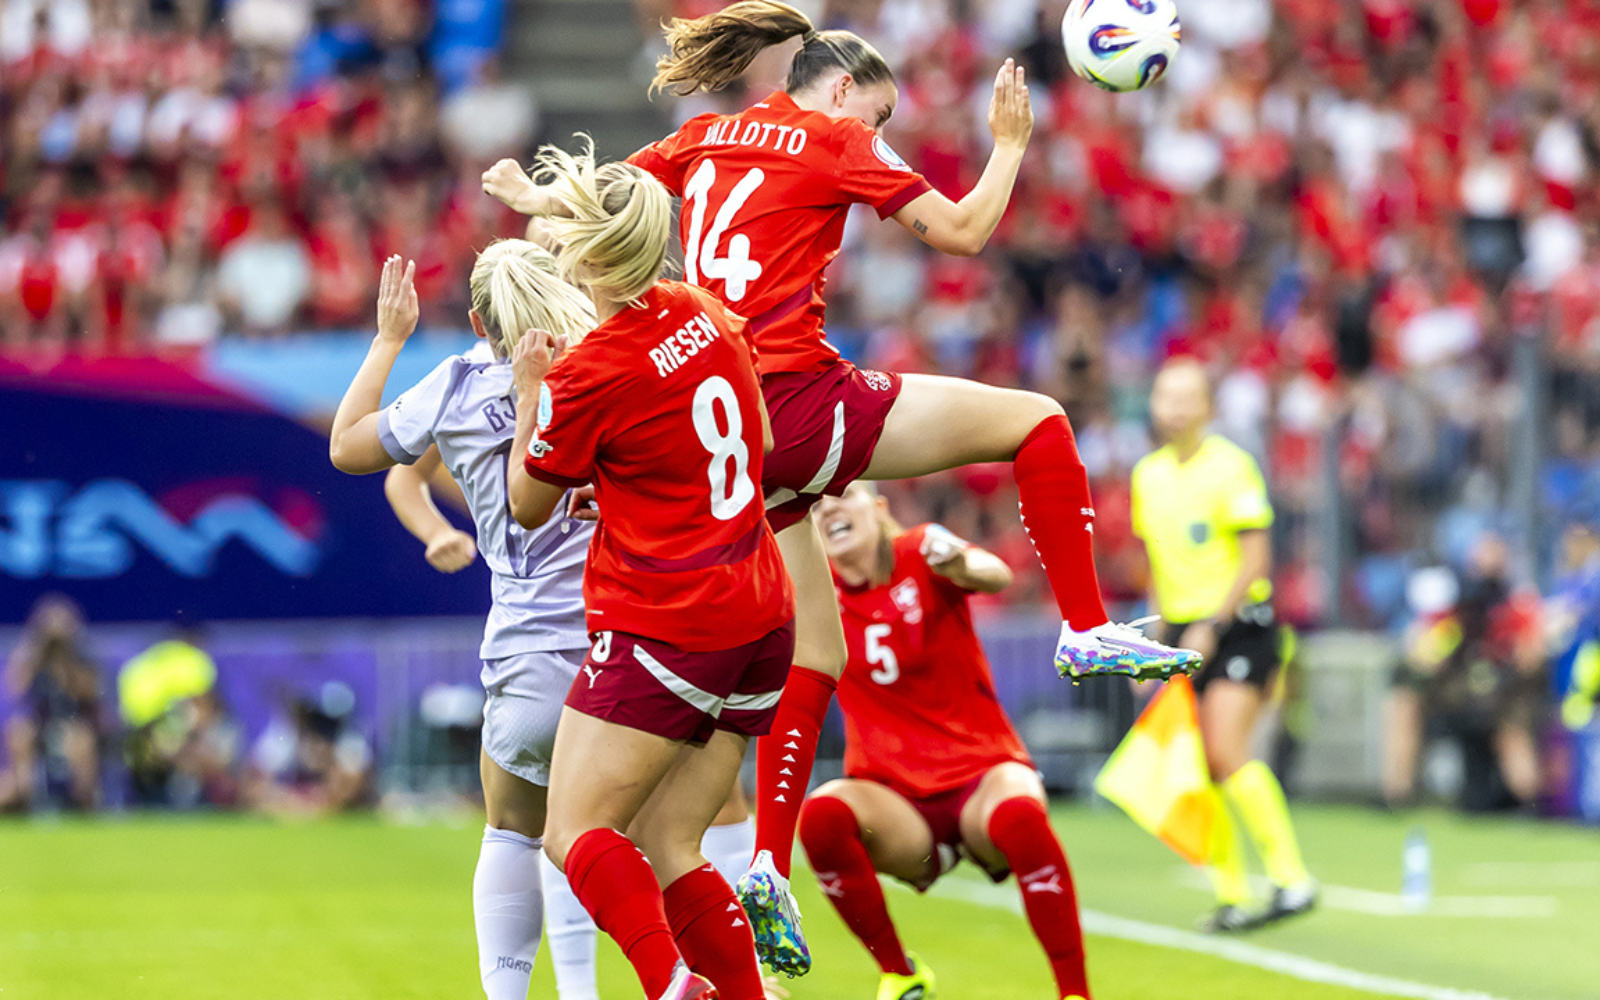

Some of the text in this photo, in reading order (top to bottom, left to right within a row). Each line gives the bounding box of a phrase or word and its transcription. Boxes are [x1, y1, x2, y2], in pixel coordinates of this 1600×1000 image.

[684, 158, 765, 302] 14
[648, 311, 720, 378] RIESEN
[691, 375, 755, 521] 8
[864, 623, 900, 685] 5
